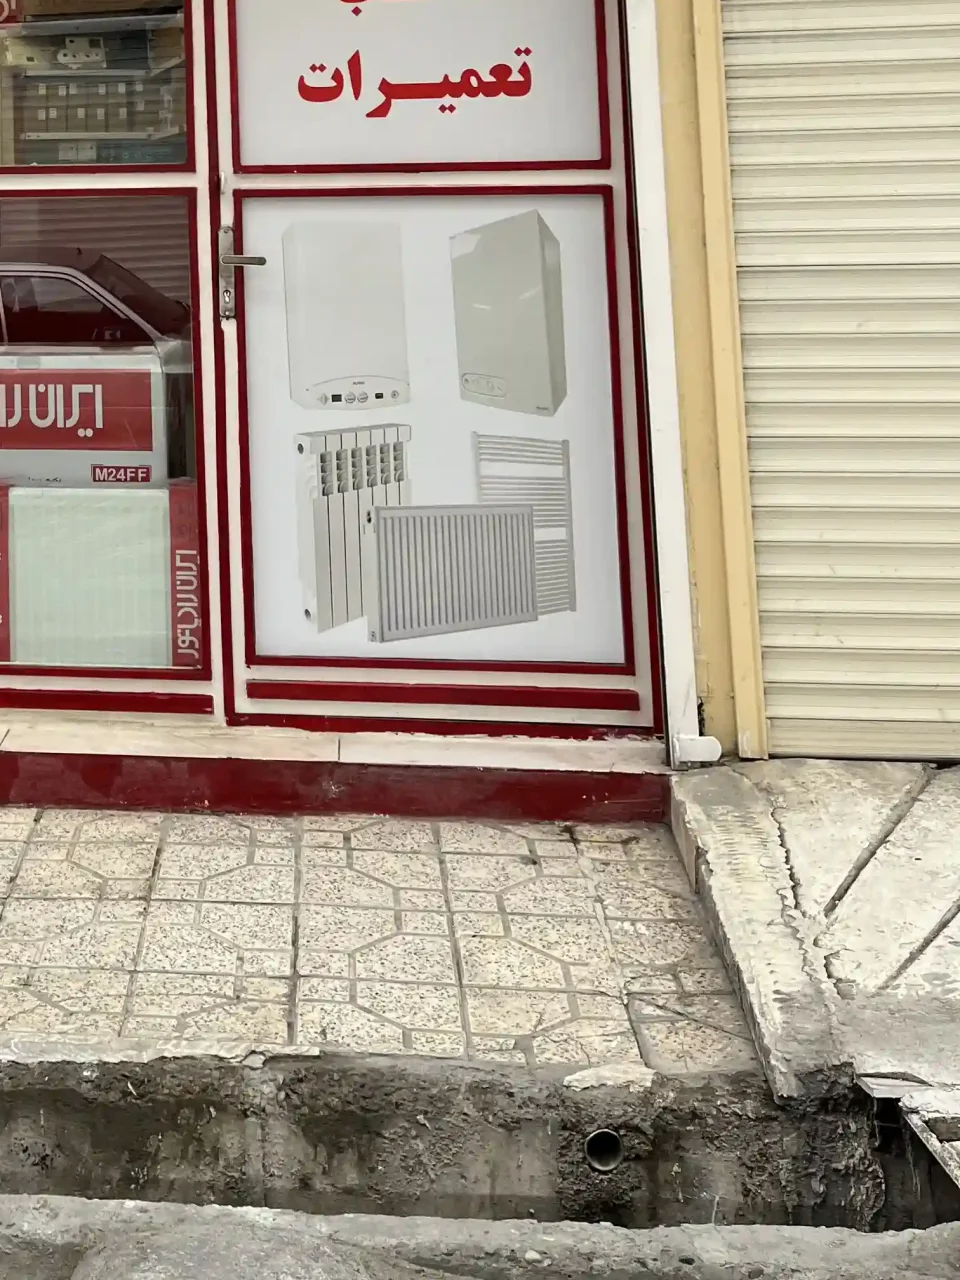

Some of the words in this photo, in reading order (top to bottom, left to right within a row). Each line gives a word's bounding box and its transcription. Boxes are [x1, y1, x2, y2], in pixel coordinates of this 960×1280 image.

[297, 46, 534, 118] تعمیرات
[28, 383, 103, 437] ایران
[95, 467, 147, 482] M24FF
